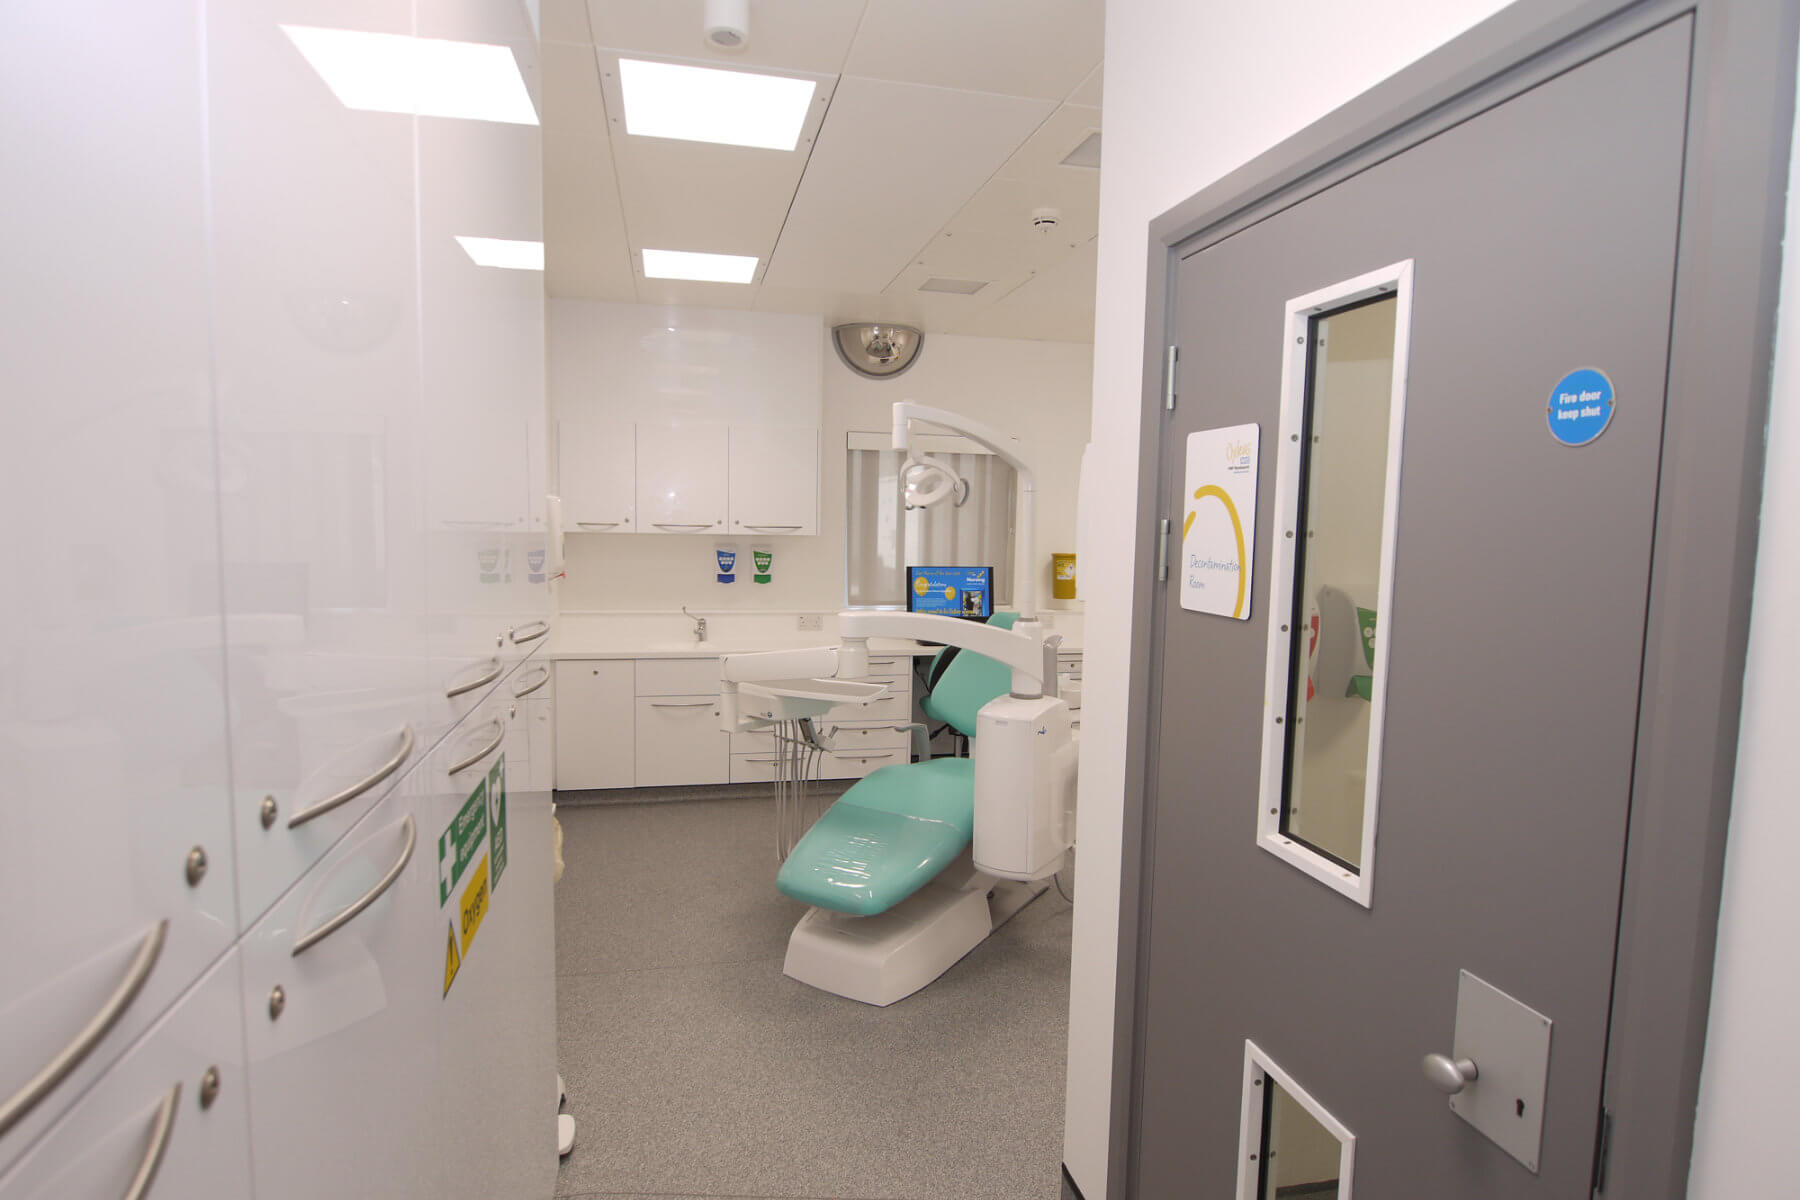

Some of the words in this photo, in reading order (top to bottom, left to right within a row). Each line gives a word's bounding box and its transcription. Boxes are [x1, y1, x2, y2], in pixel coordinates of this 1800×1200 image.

[1559, 393, 1578, 405] Fire
[1579, 390, 1602, 402] door
[1558, 409, 1579, 421] keep
[1581, 406, 1601, 418] shut
[1189, 554, 1241, 572] Decontamination
[1189, 575, 1205, 589] Room
[458, 787, 485, 835] Emergency
[460, 814, 485, 862] equipment
[464, 878, 488, 936] Oxygen
